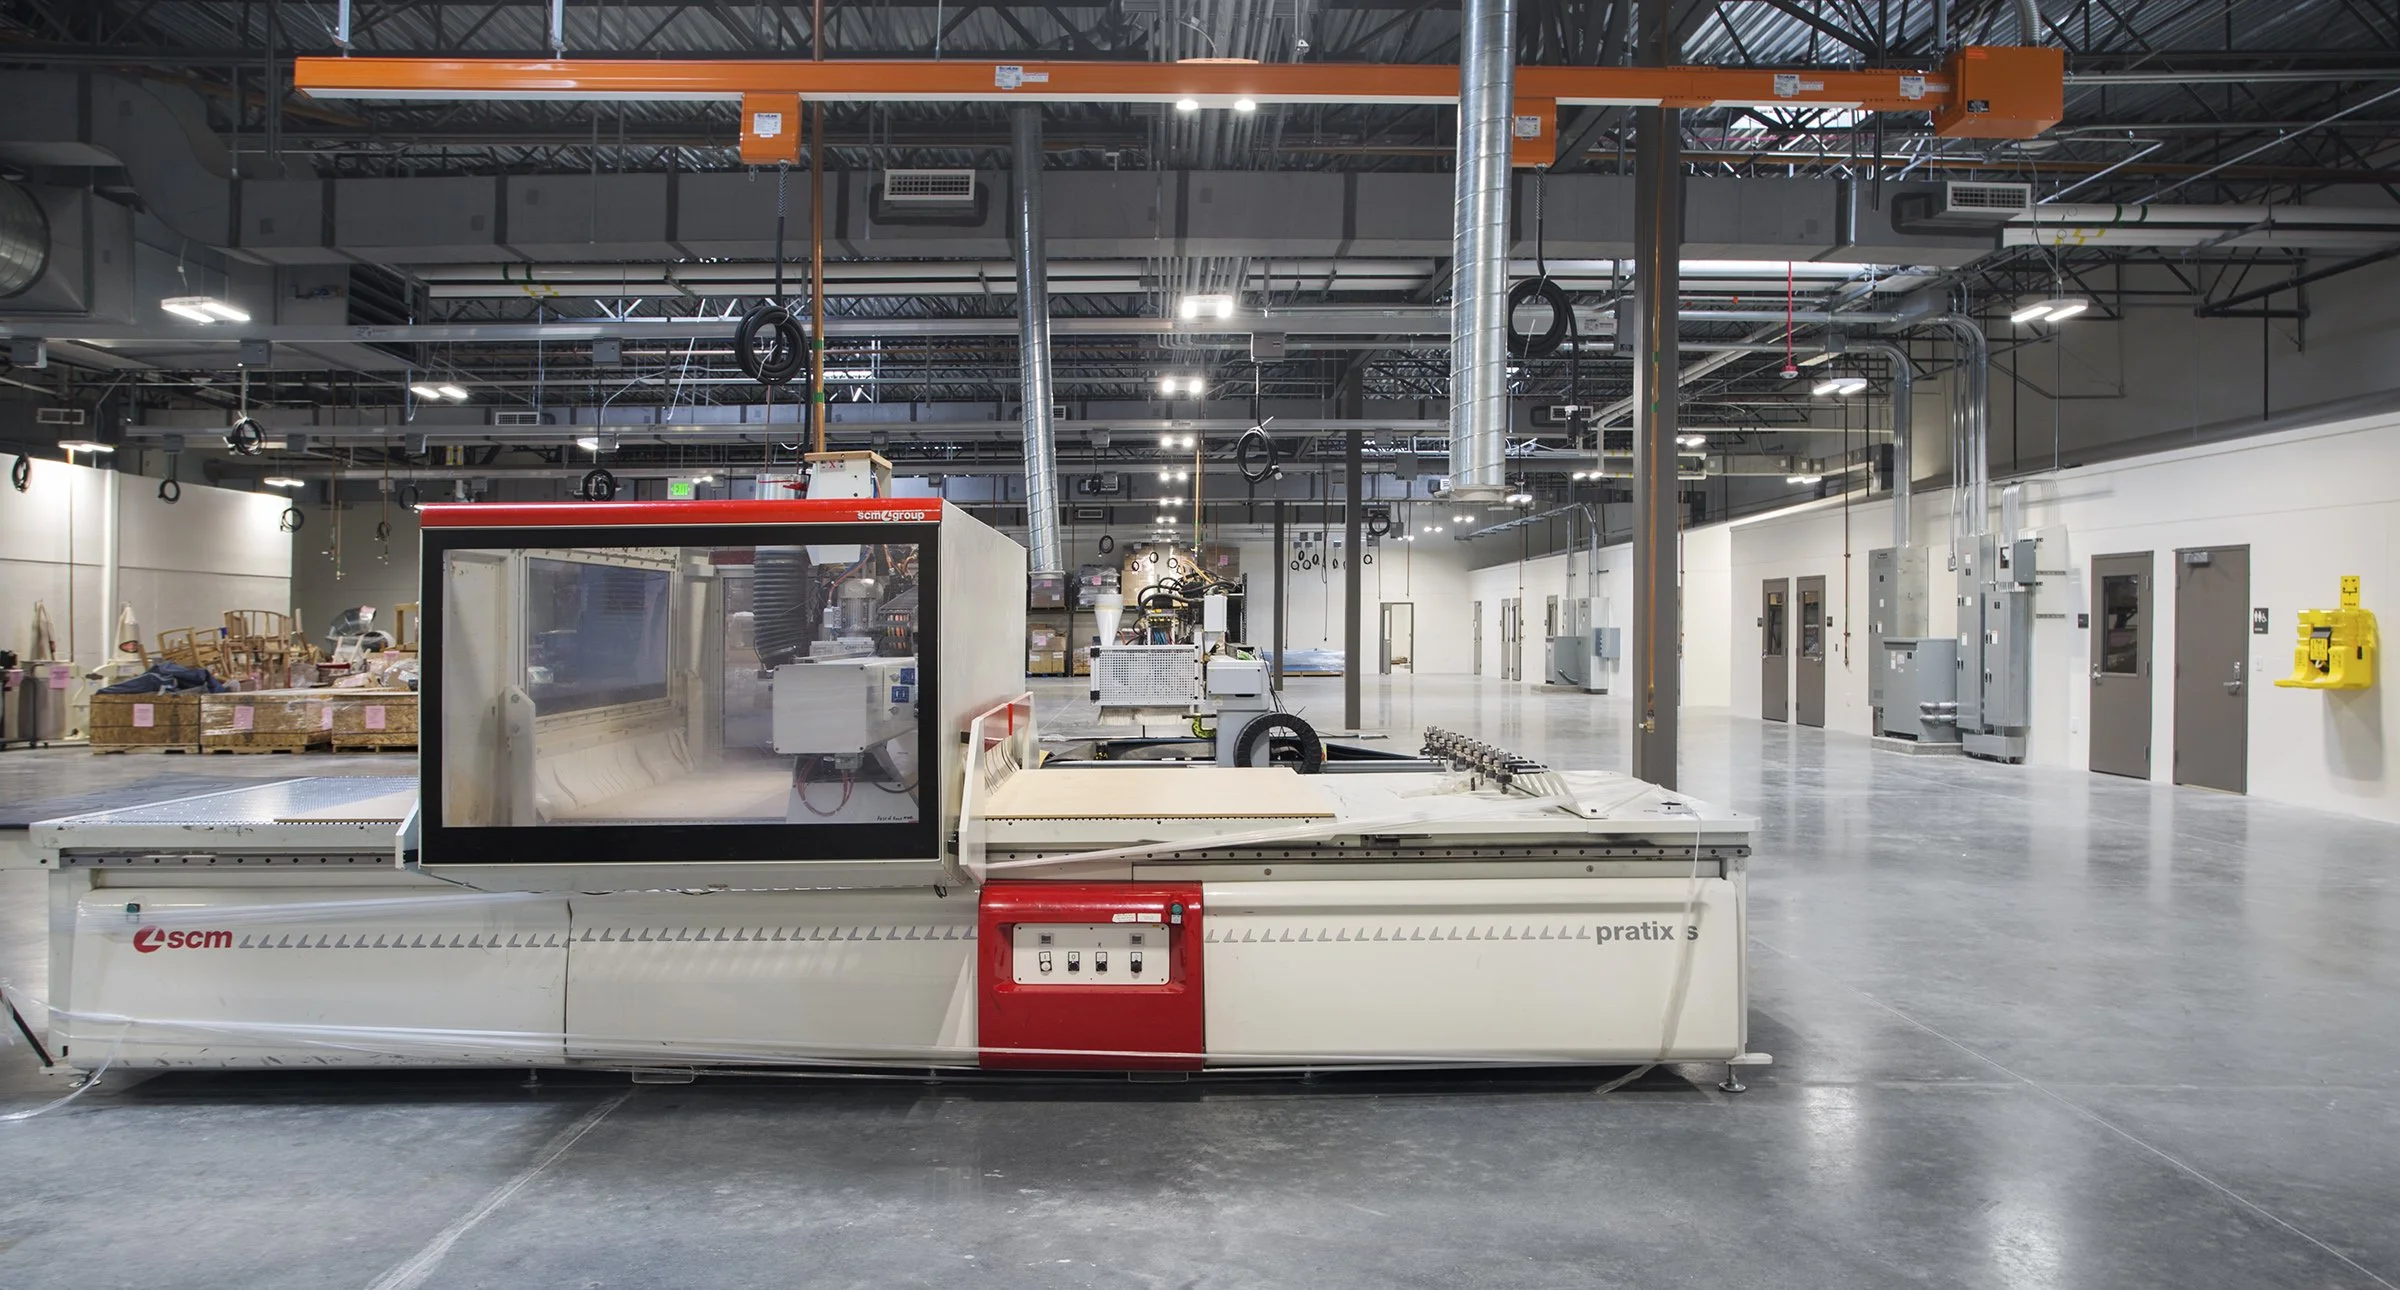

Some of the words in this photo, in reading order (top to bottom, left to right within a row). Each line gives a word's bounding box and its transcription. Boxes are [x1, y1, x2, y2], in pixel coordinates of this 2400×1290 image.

[857, 511, 880, 520] scm
[892, 511, 925, 521] group
[167, 930, 233, 949] scm
[1596, 920, 1675, 945] pratix
[1687, 925, 1699, 941] s
